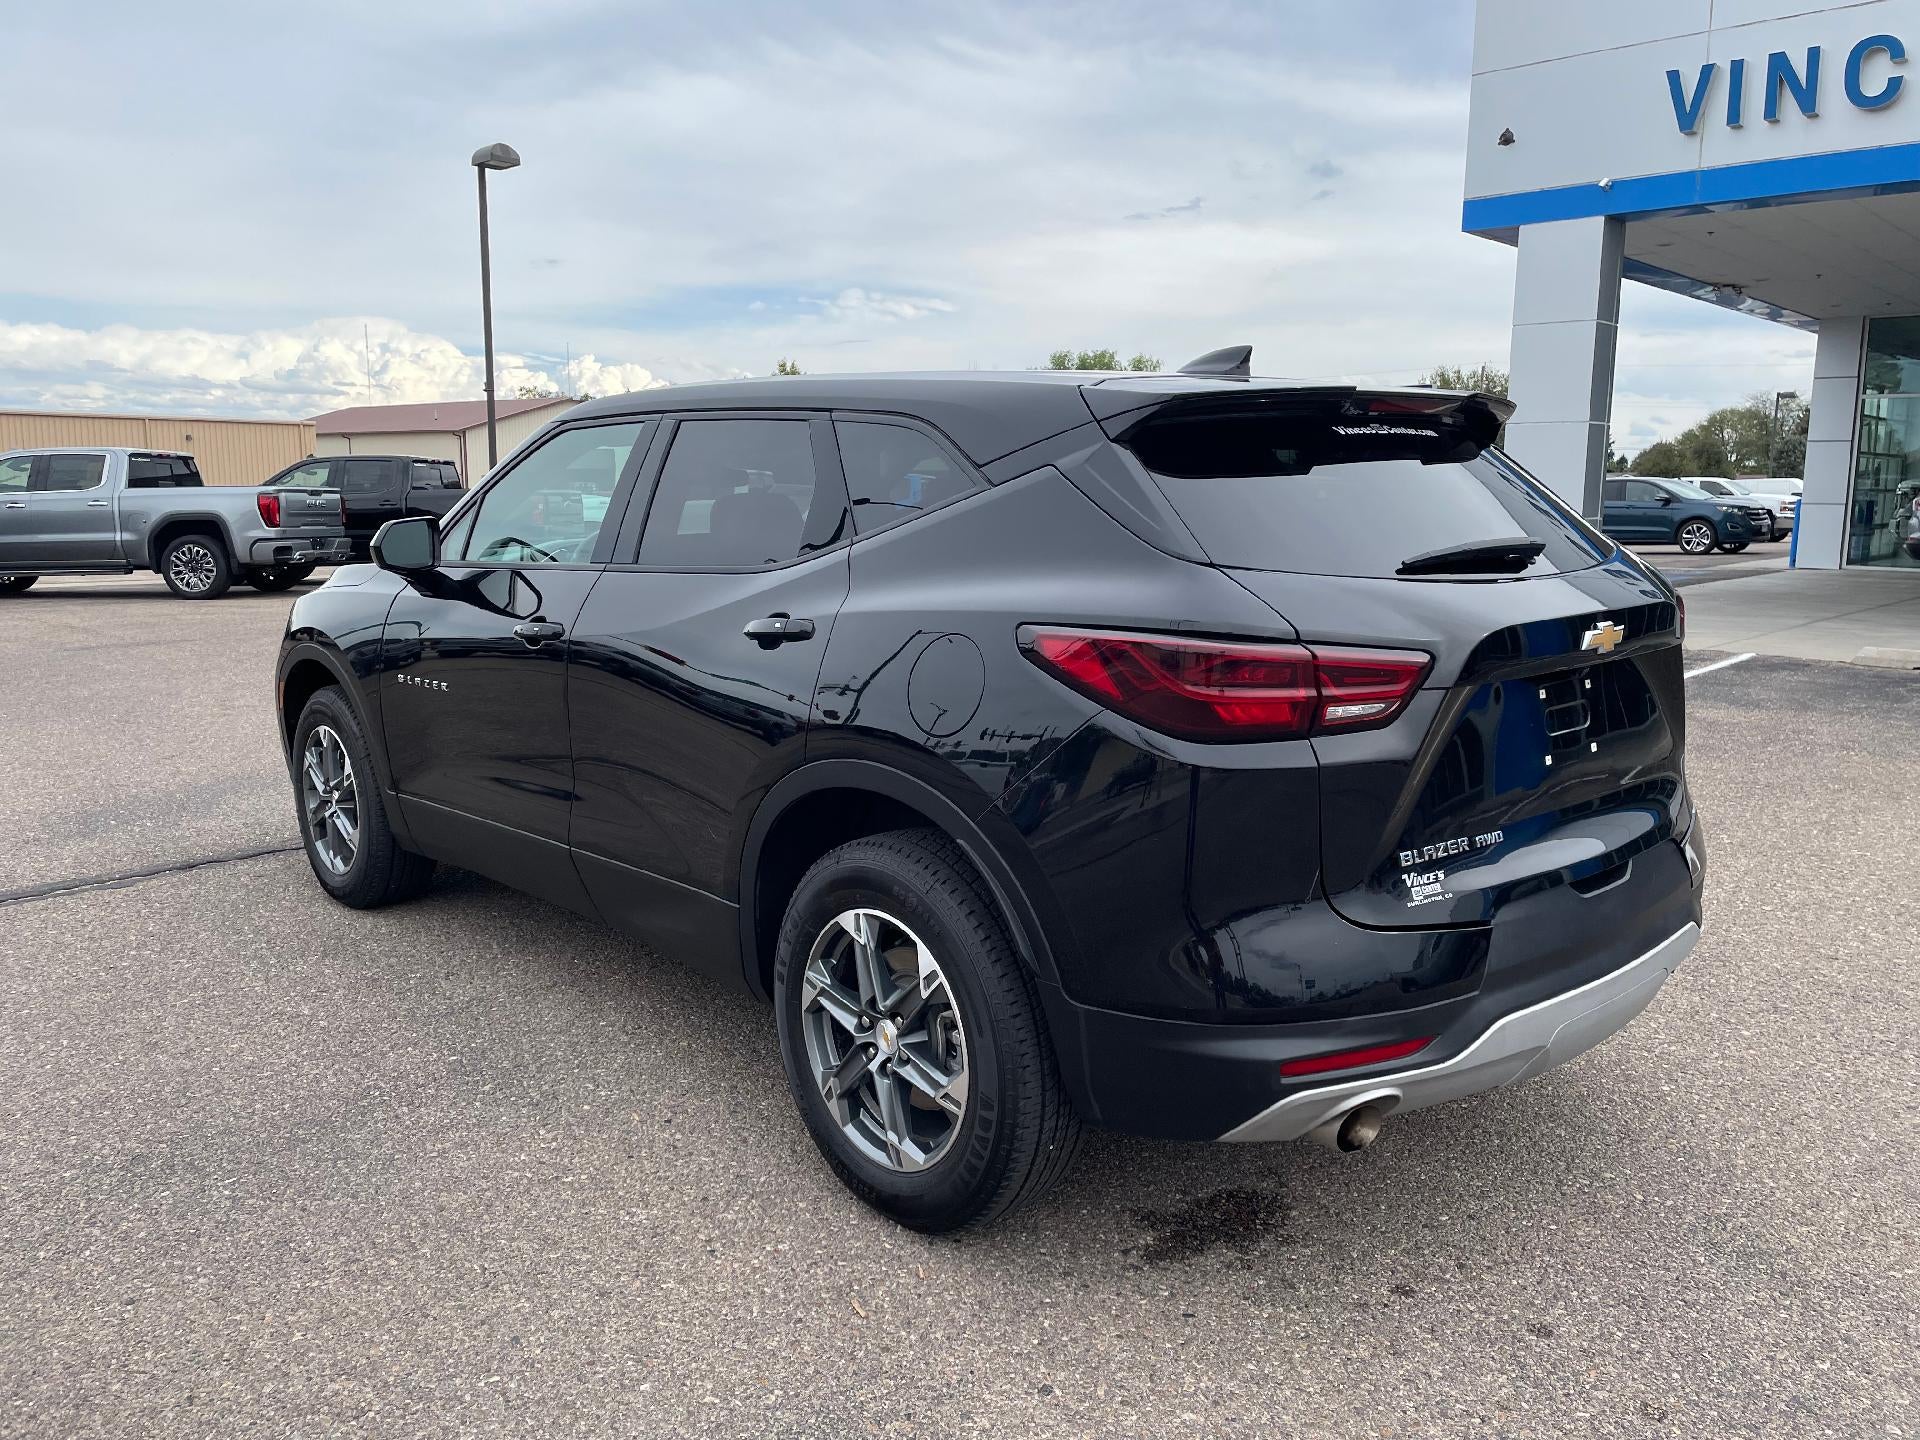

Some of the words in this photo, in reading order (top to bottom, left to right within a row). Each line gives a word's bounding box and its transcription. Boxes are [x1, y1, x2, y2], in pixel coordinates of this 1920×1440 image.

[1666, 34, 1908, 135] VINC
[397, 673, 449, 692] BLAZER
[1399, 837, 1470, 867] BLAZER
[1475, 830, 1504, 848] AWD
